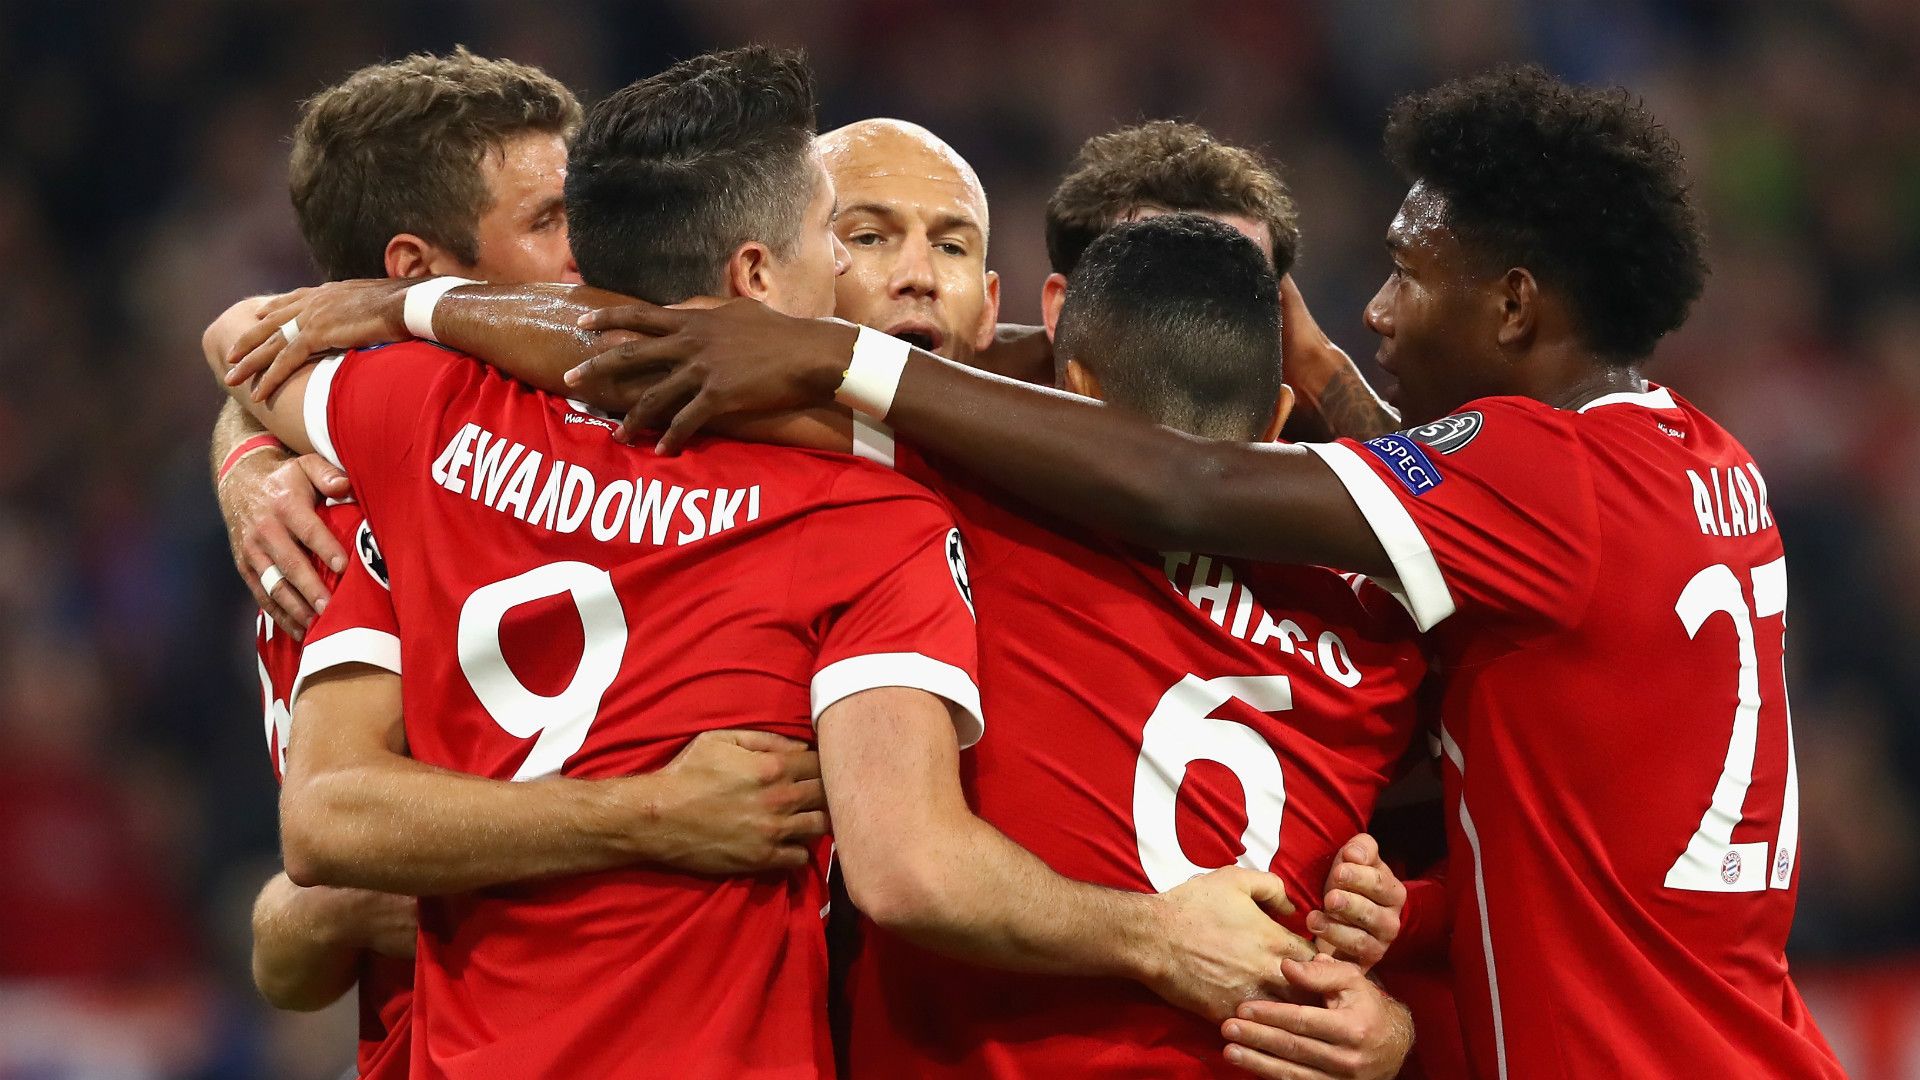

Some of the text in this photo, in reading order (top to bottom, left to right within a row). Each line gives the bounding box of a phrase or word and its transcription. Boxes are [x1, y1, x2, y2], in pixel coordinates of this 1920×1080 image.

[1420, 425, 1444, 436] 5
[1686, 462, 1773, 538] ALABA
[457, 561, 629, 782] 9
[1664, 555, 1799, 892] 27
[1132, 673, 1293, 892] 6
